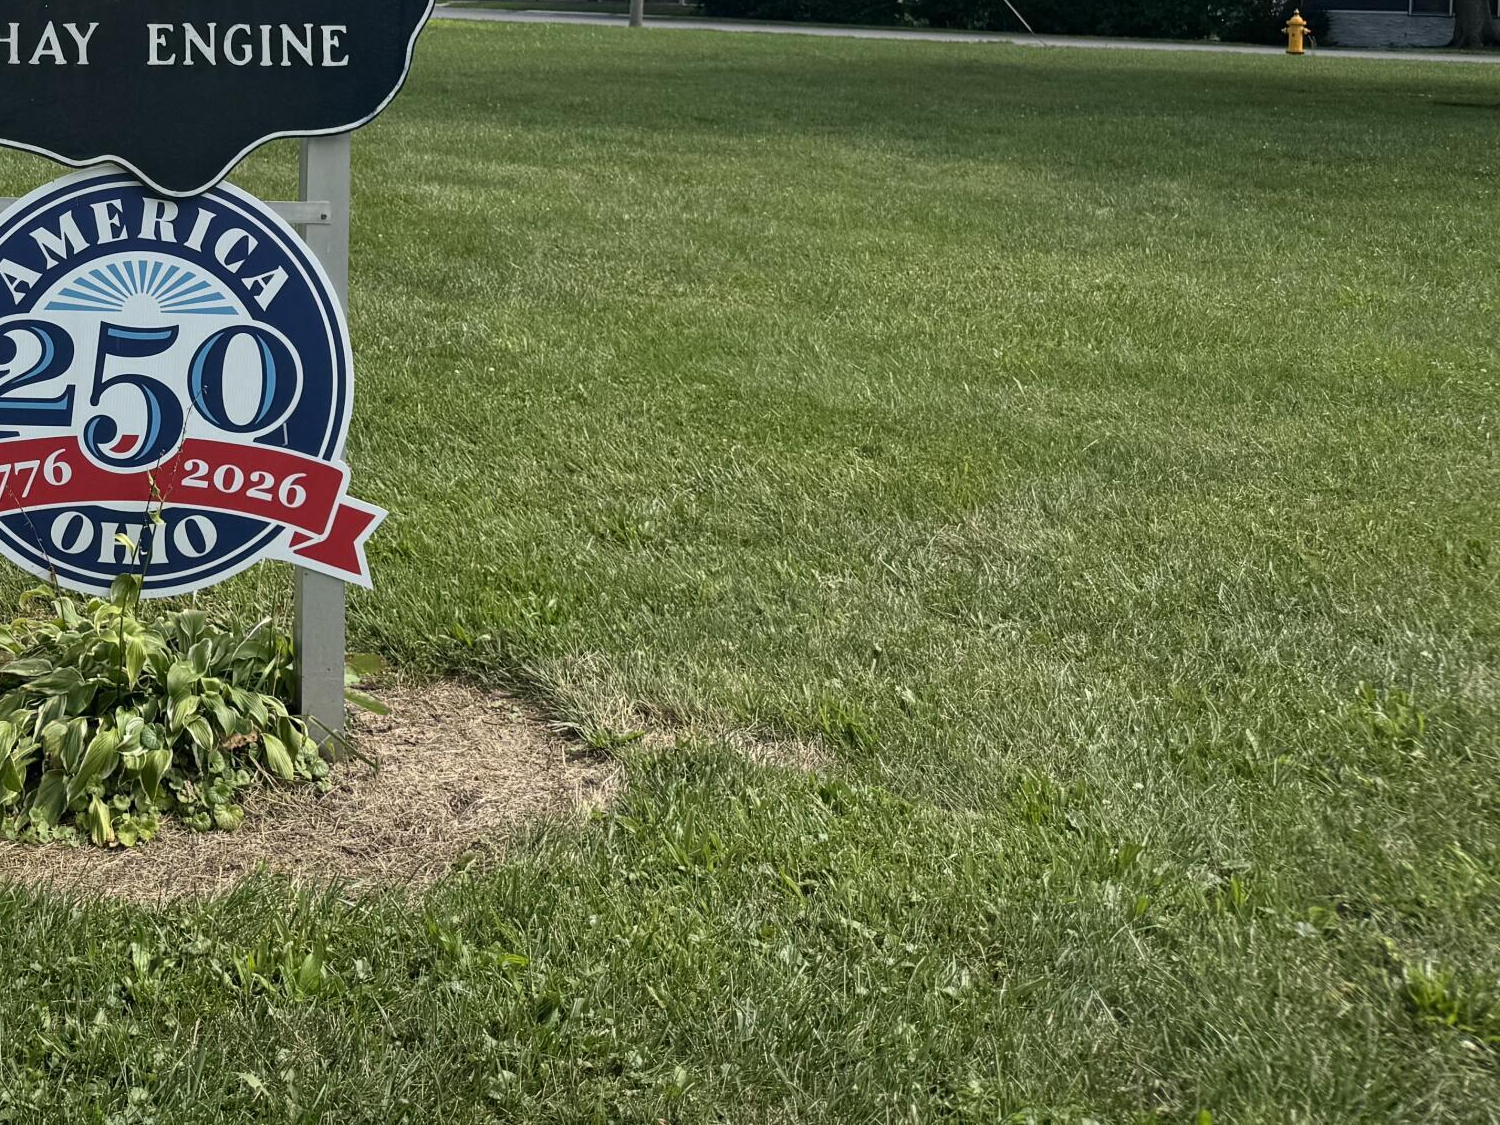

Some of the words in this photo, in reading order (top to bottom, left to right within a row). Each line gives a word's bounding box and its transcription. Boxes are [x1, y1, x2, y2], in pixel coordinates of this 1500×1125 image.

[146, 23, 350, 67] ENGINE
[181, 457, 308, 508] 2026
[51, 511, 217, 565] OHIO
